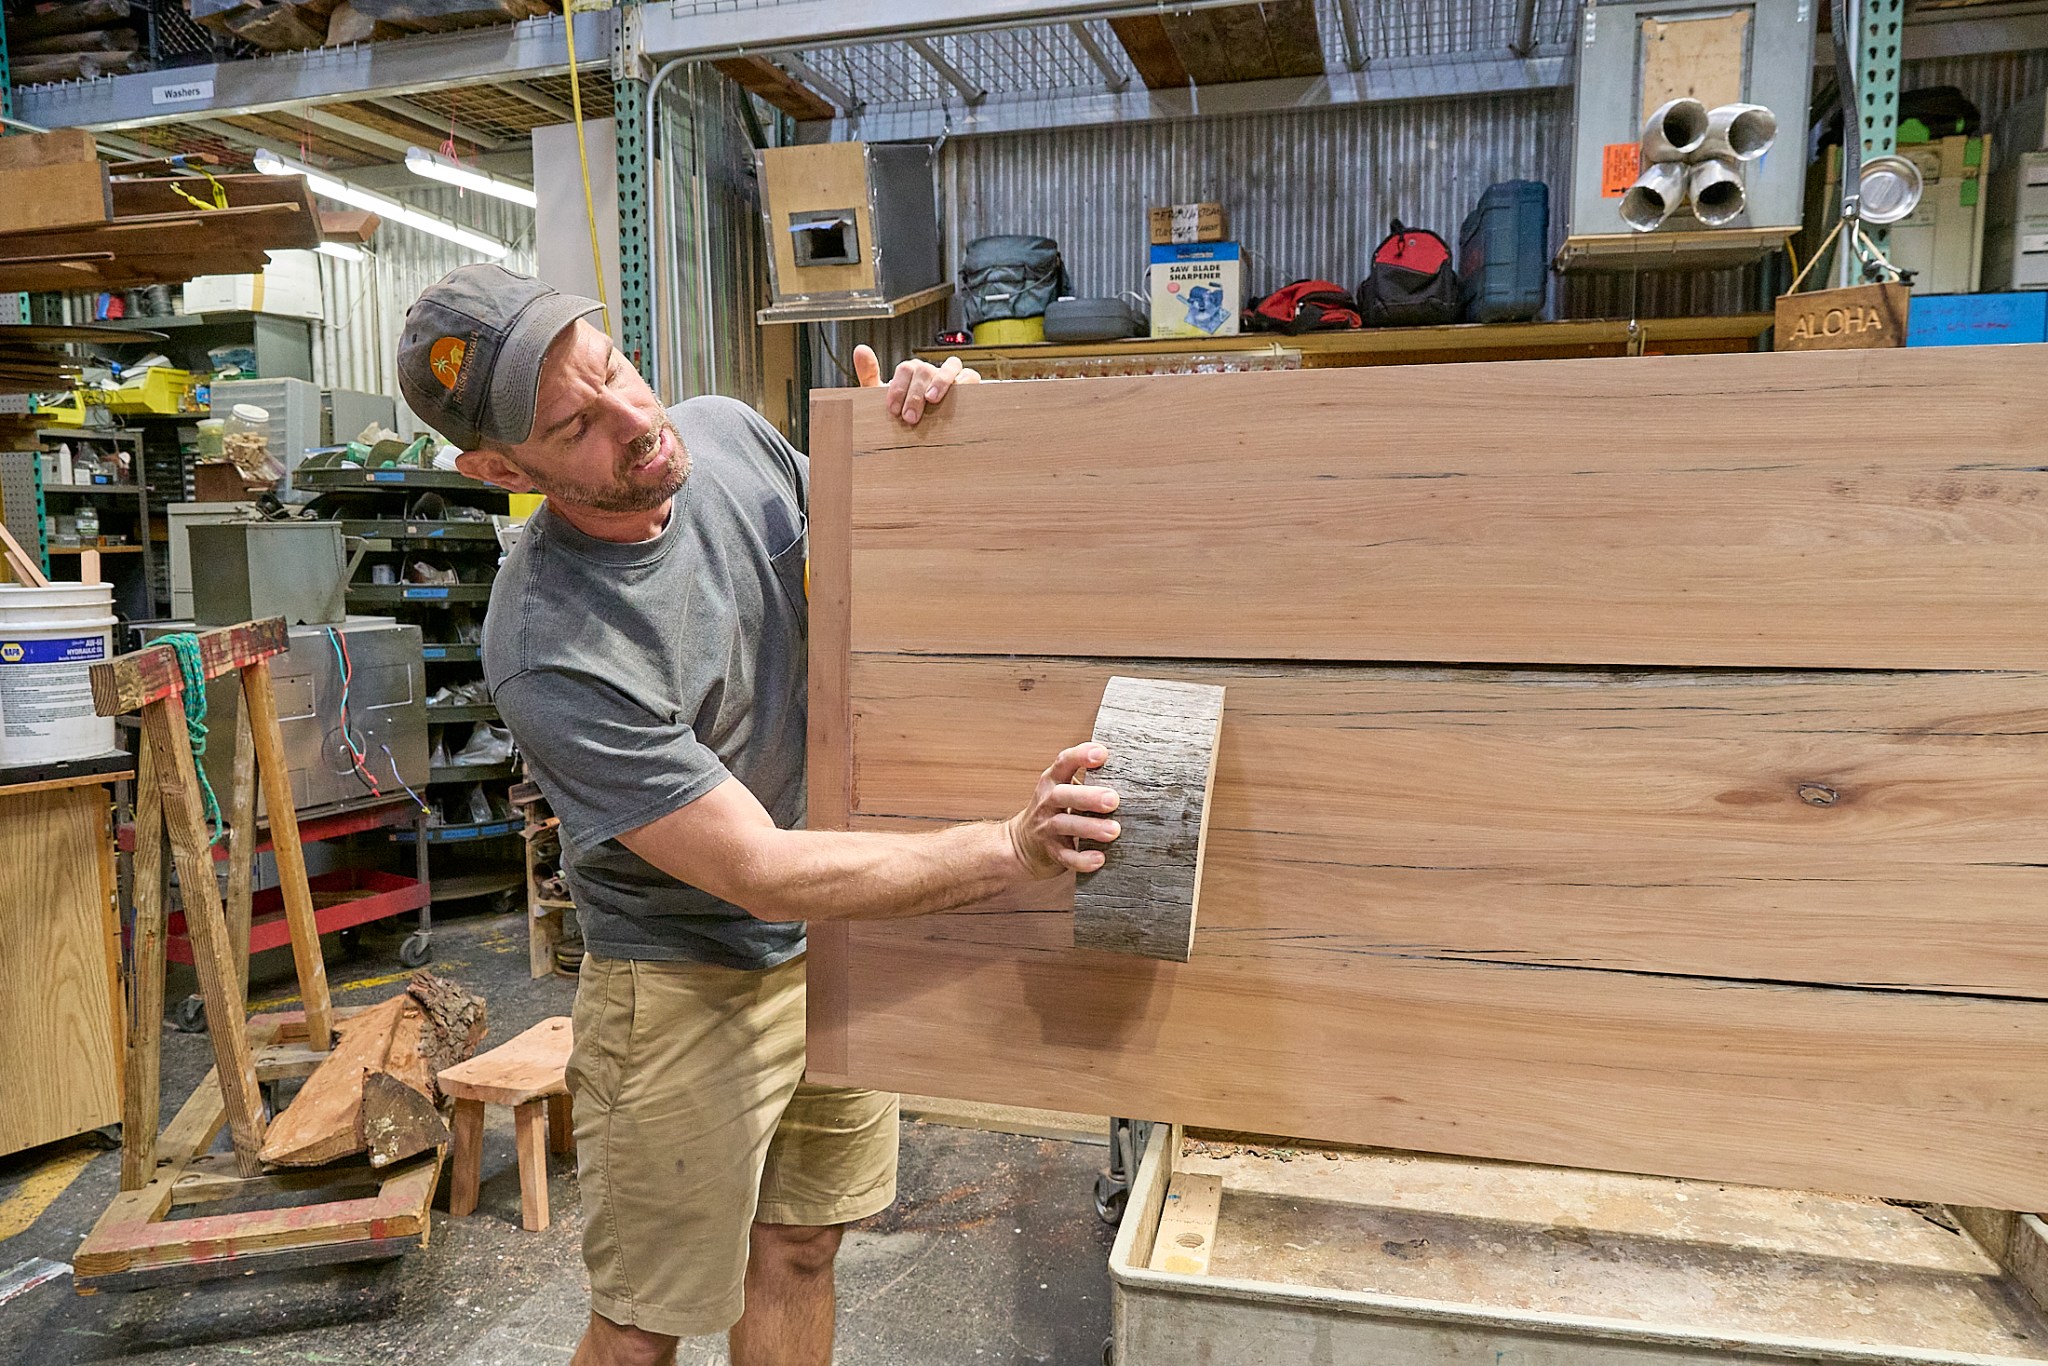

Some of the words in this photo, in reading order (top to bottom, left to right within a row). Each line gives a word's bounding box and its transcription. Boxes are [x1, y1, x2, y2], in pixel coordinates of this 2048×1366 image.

[164, 88, 201, 98] Washers
[1193, 264, 1221, 272] BLADE
[1169, 272, 1222, 281] SHARPENER
[1789, 304, 1882, 341] ALOHA
[4, 648, 20, 657] NAPA
